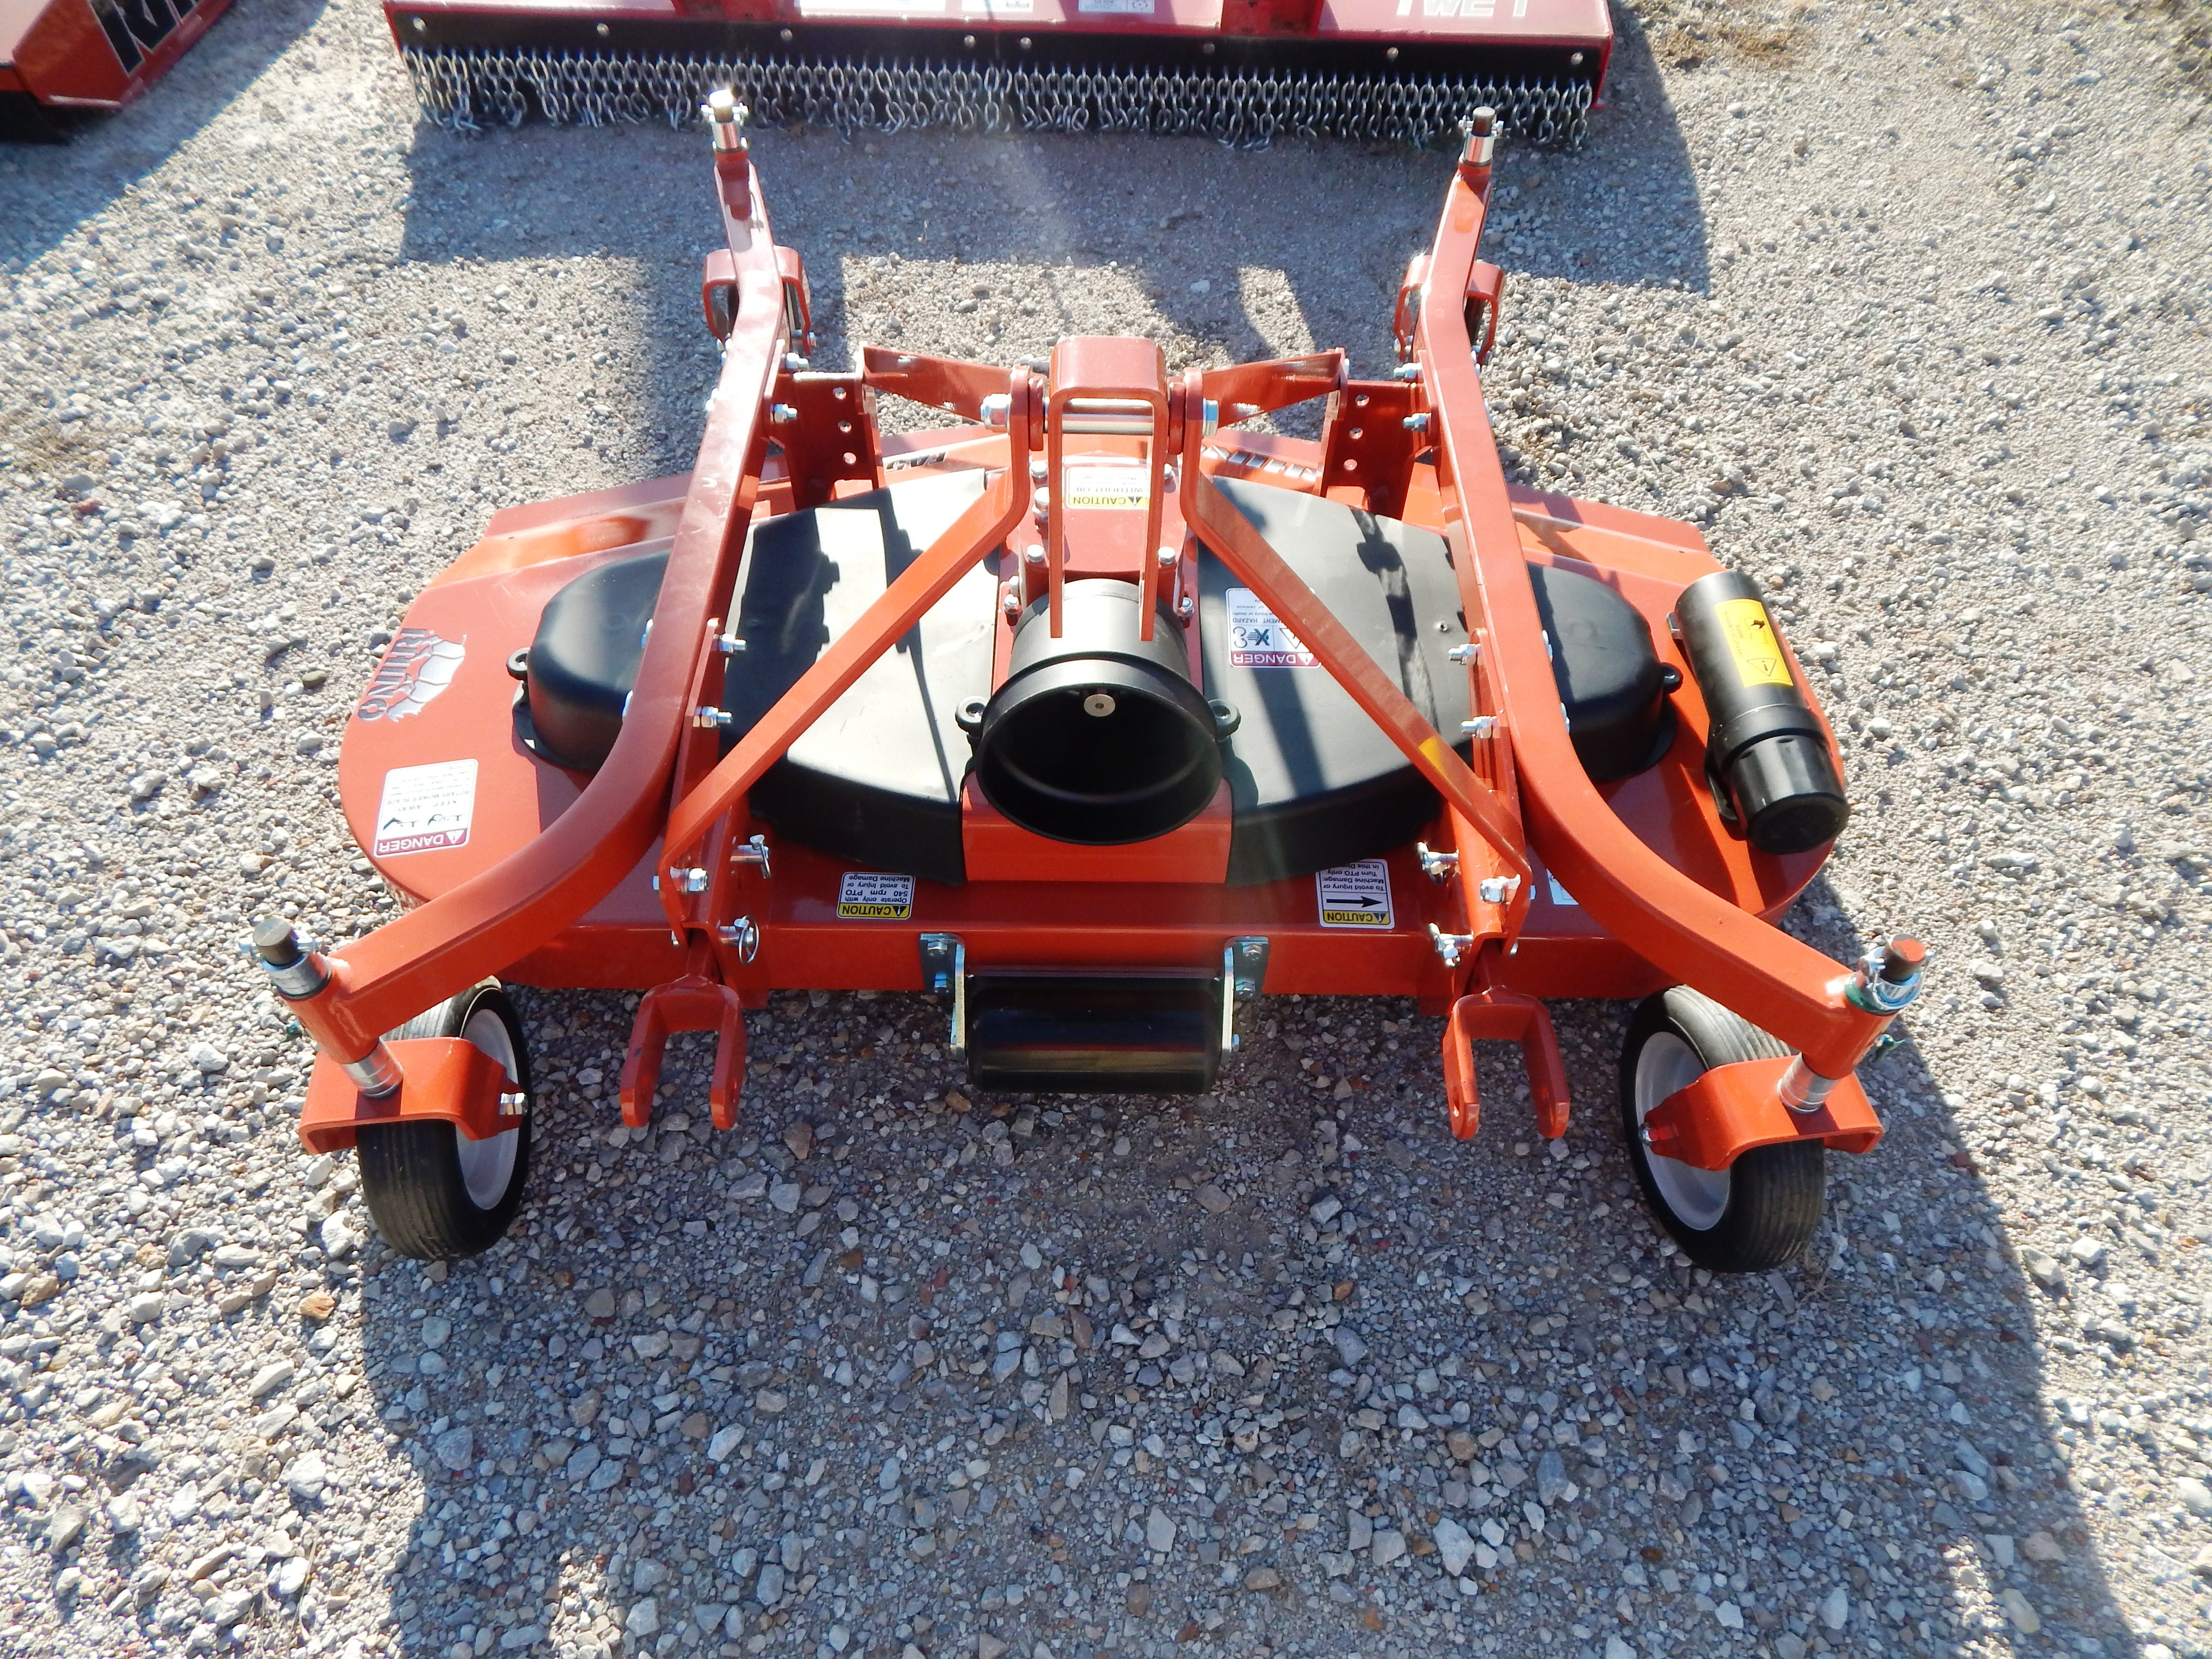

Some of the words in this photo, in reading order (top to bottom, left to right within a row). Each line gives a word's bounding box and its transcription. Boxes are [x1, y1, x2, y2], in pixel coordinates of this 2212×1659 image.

[1234, 654, 1296, 663] DANGER
[379, 834, 444, 852] DANGER
[842, 906, 891, 915] CAUTION
[1327, 913, 1372, 922] CAUTION
